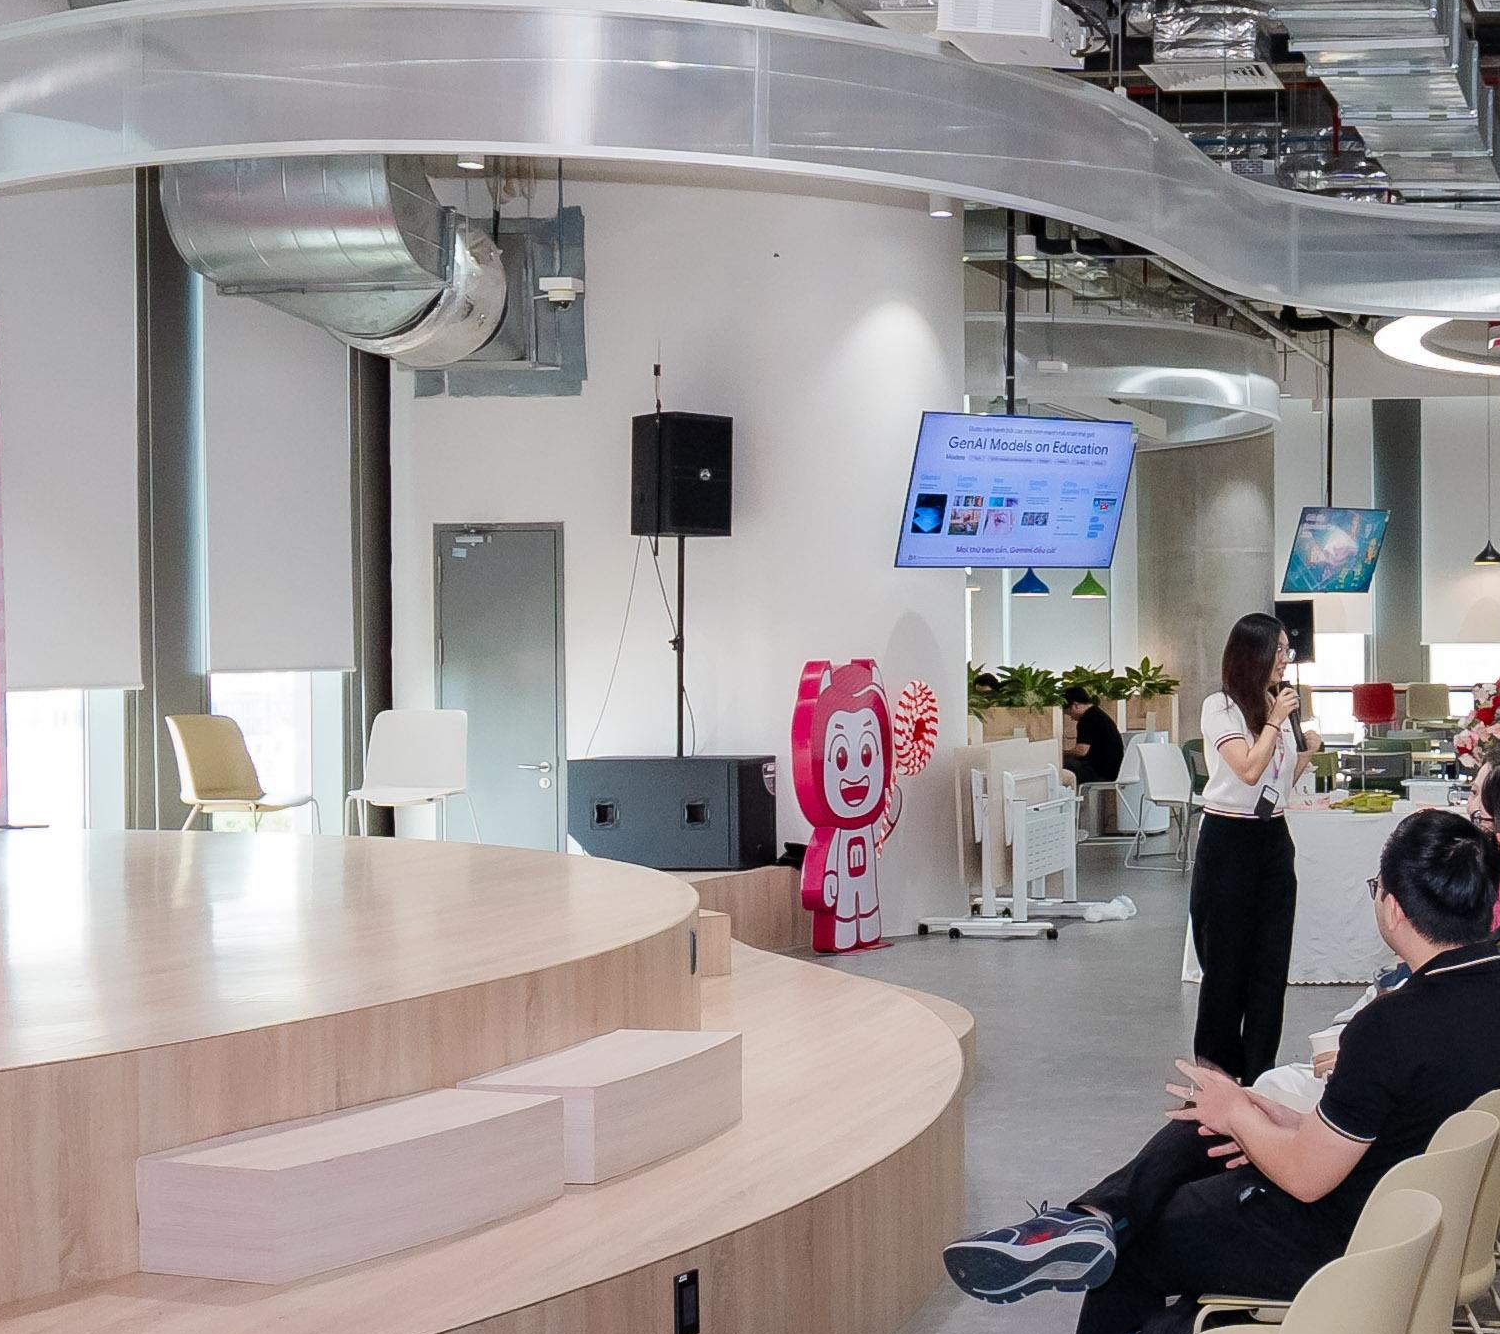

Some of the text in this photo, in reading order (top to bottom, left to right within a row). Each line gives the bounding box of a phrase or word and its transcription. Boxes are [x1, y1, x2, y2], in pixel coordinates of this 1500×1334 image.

[948, 435, 1110, 456] GenAI Models on Education
